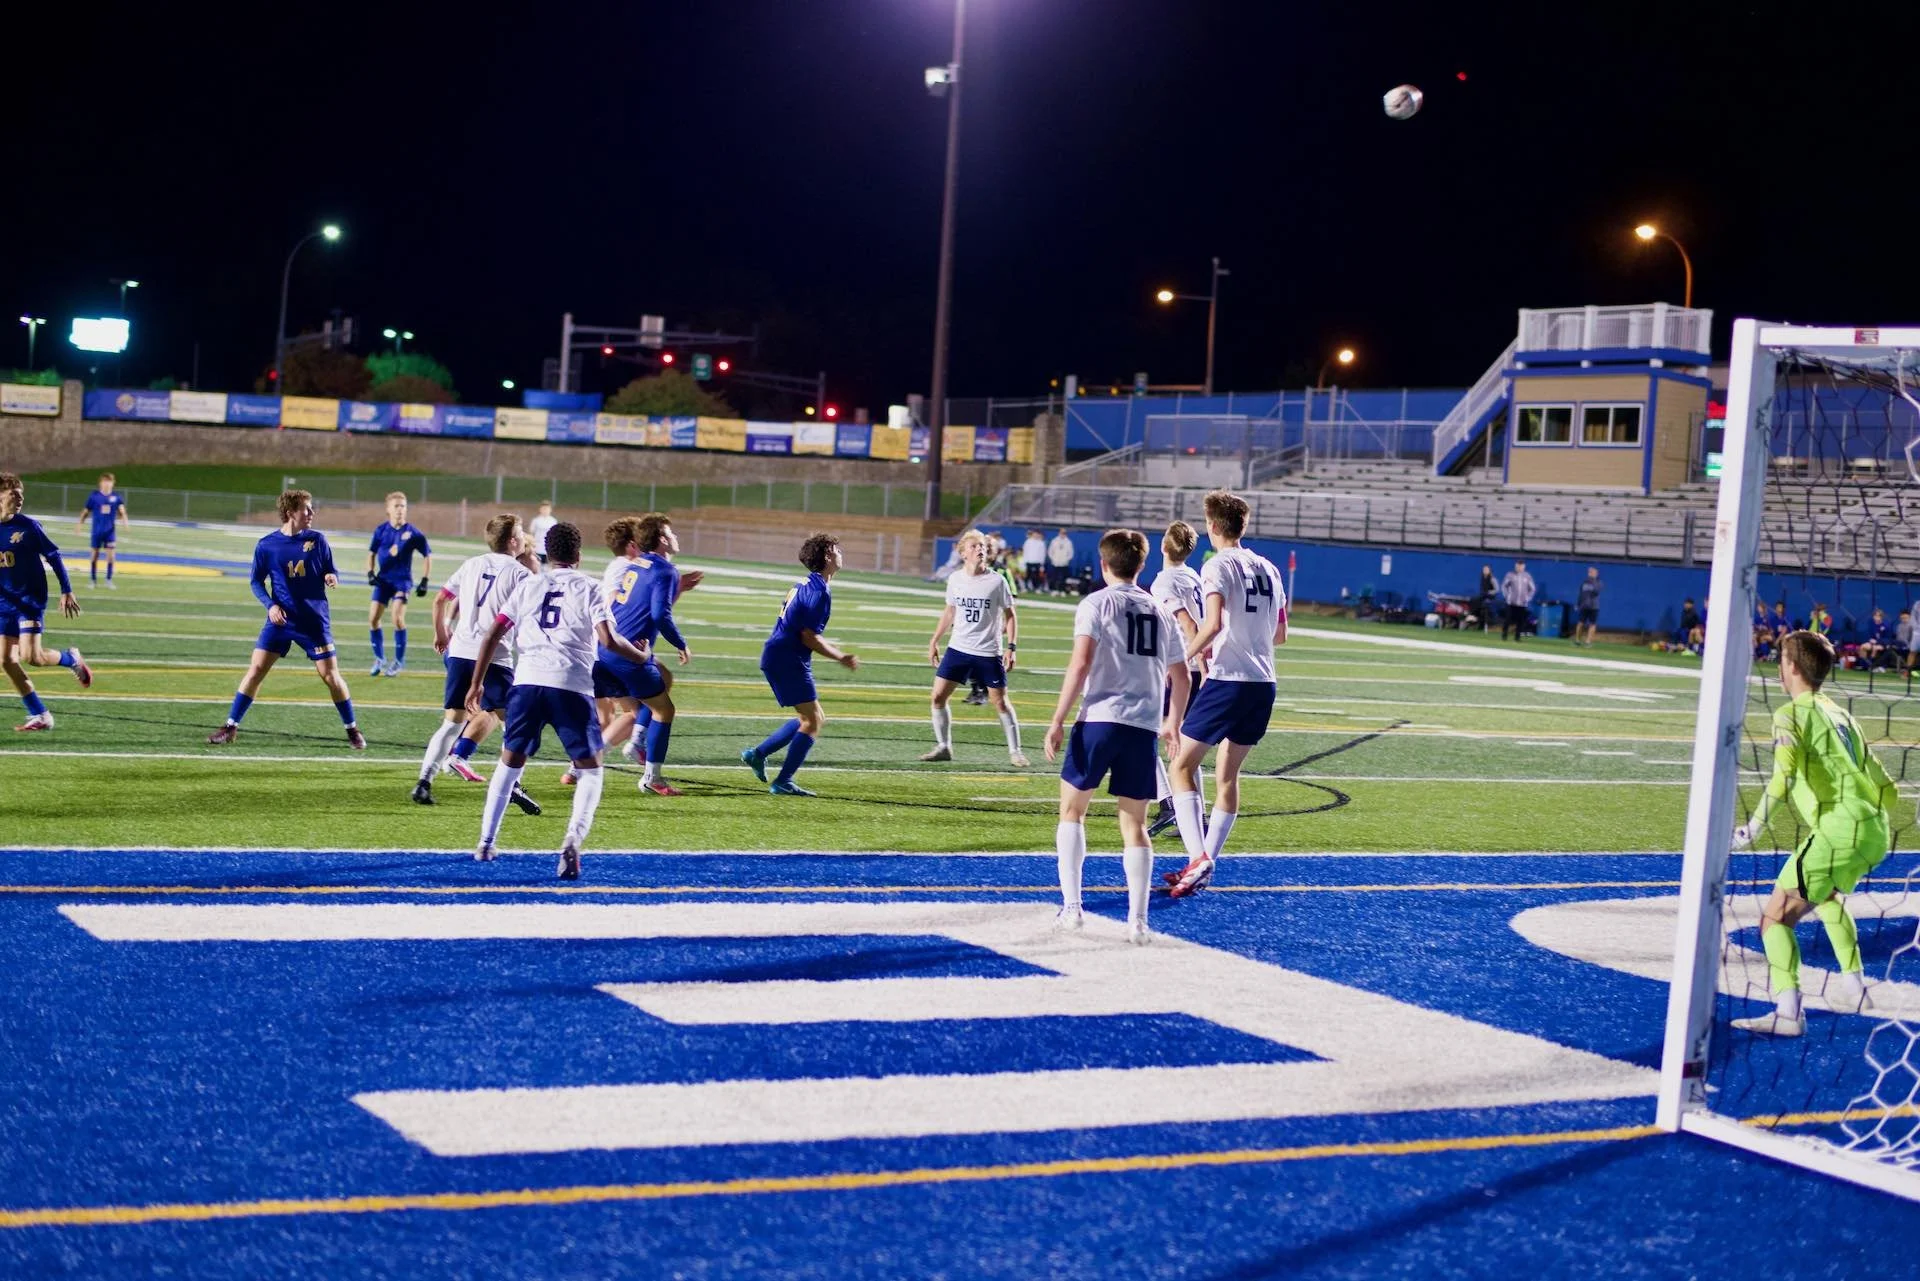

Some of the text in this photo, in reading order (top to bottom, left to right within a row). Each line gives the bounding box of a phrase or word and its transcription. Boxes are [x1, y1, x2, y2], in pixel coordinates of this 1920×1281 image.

[288, 560, 306, 577] 14
[477, 573, 496, 607] 7
[616, 570, 638, 605] 9
[954, 597, 991, 609] CADETS
[1245, 573, 1274, 613] 24
[540, 591, 565, 629] 6
[965, 609, 980, 623] 20
[1125, 611, 1159, 657] 10
